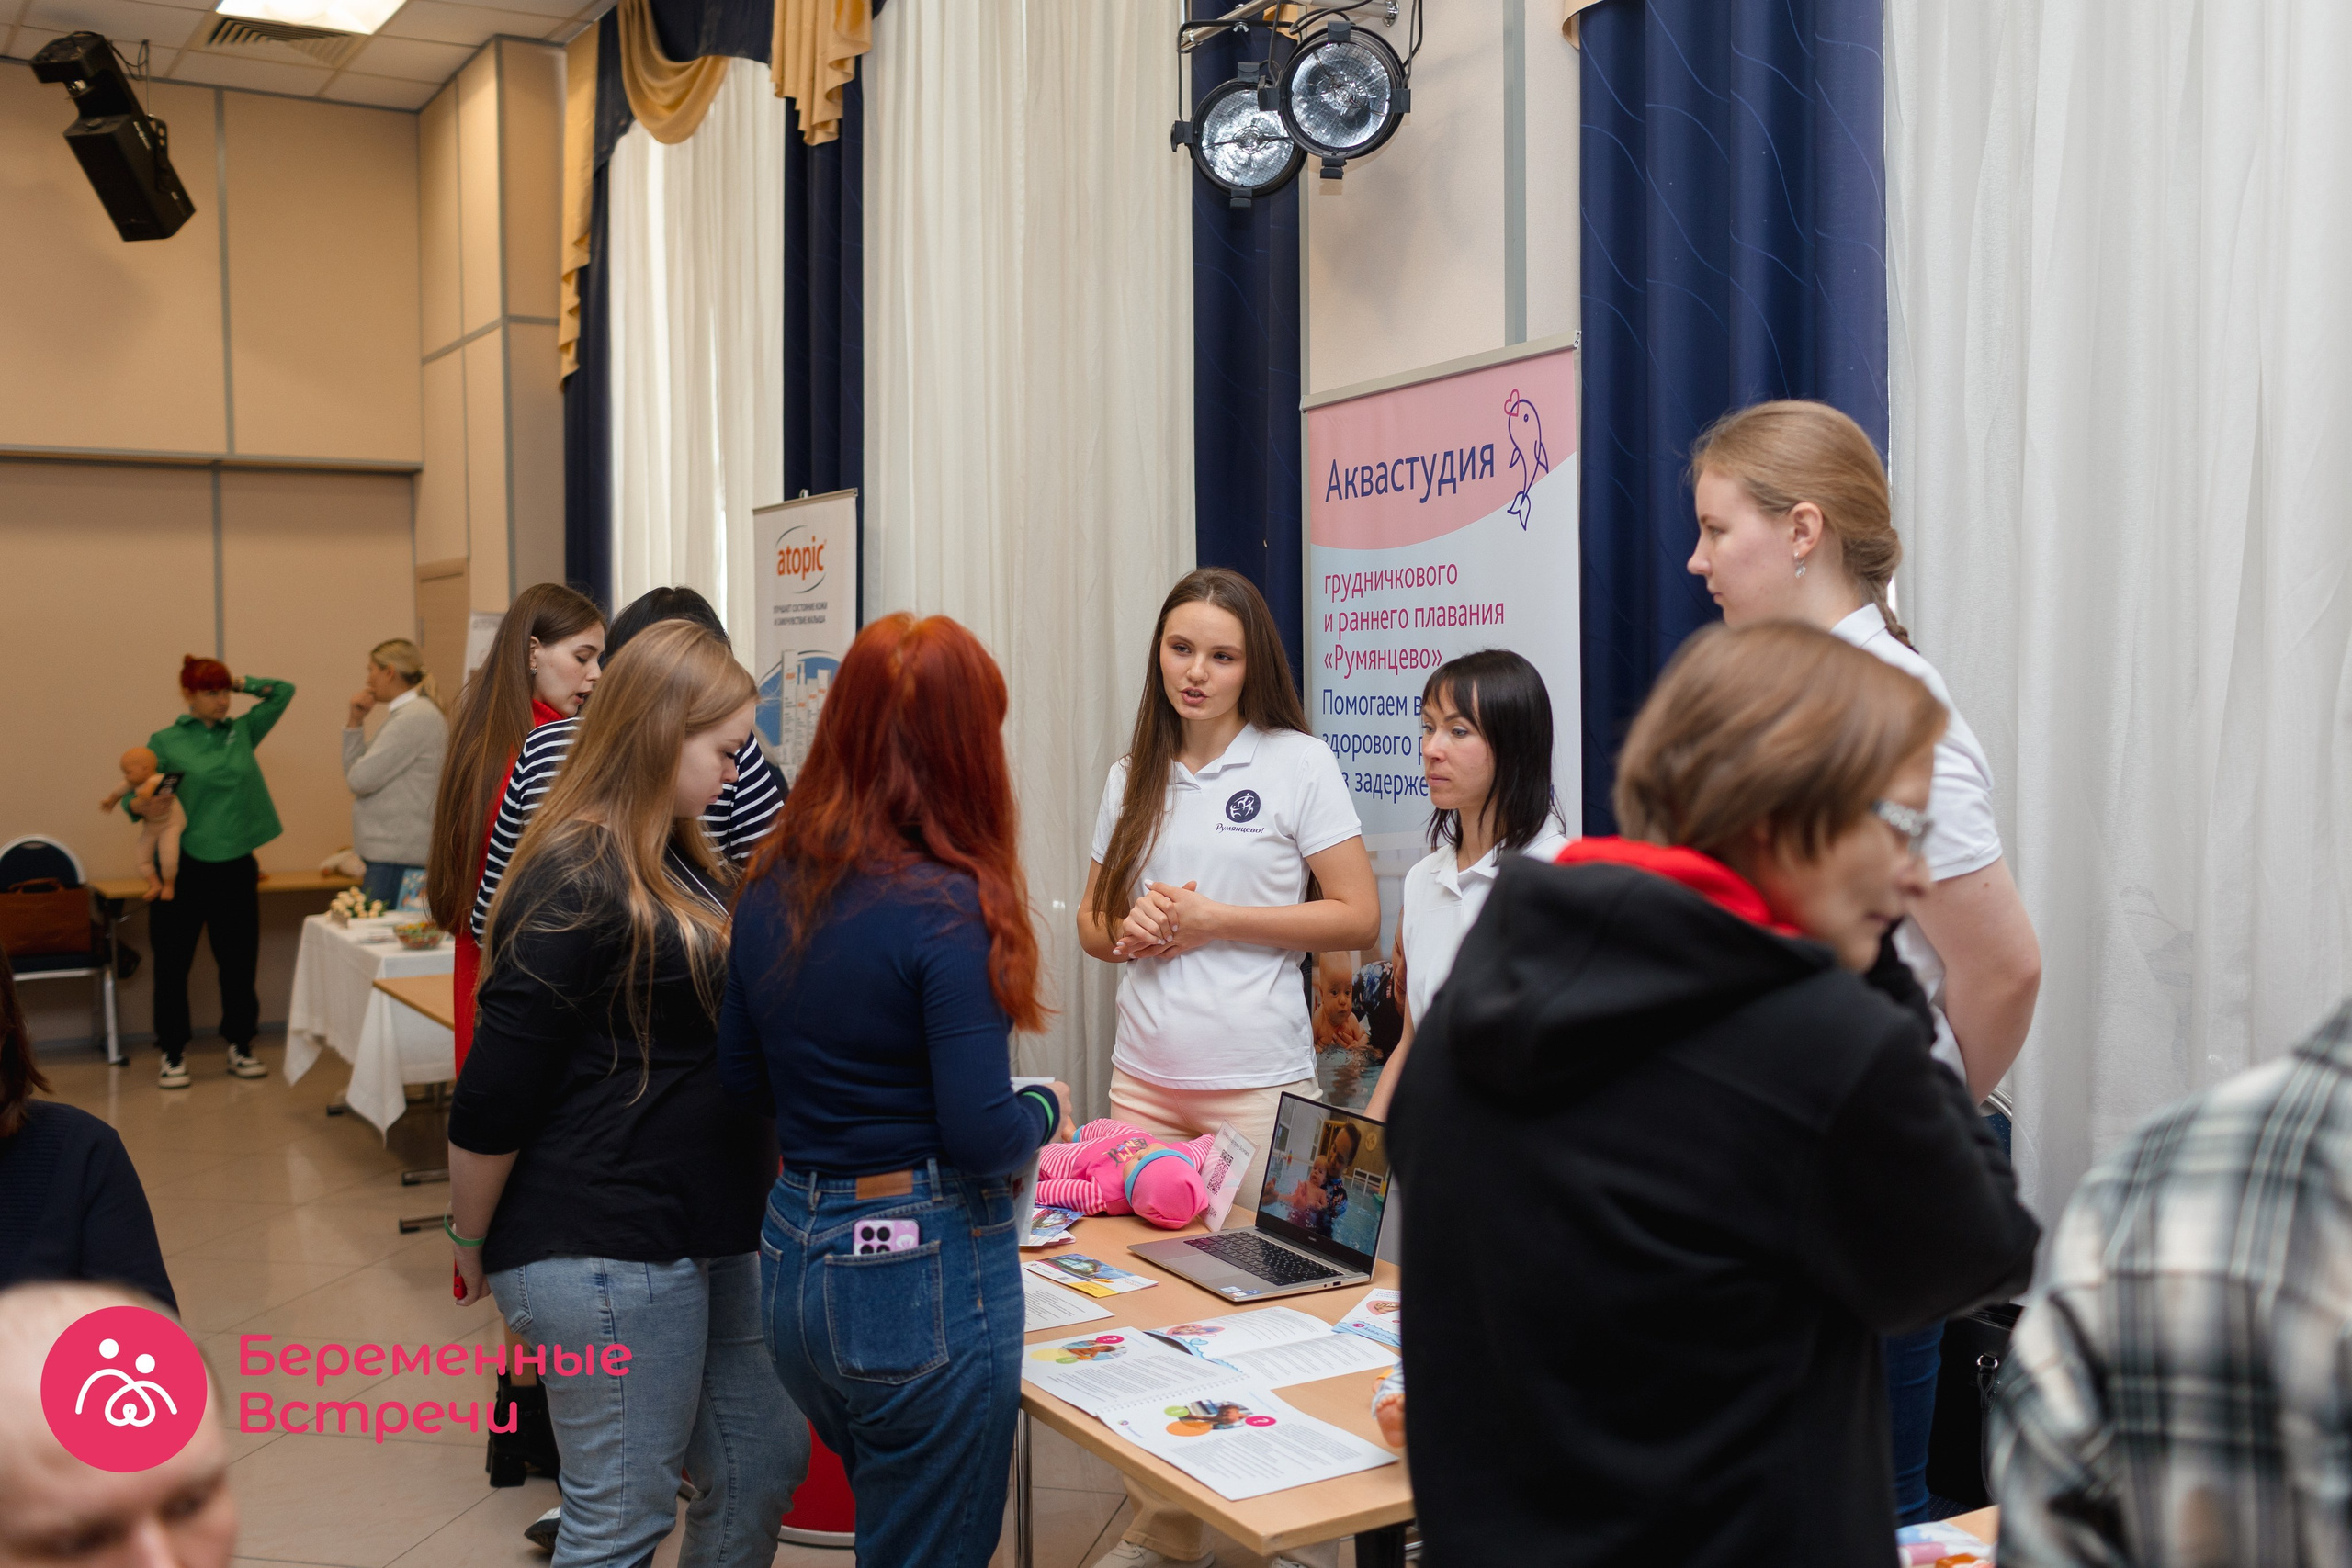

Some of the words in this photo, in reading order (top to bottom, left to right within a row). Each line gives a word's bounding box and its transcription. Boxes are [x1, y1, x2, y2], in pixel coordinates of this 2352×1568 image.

[1325, 443, 1495, 504] Аквастудия
[776, 535, 825, 581] atopic
[1324, 563, 1458, 603] грудничкового
[1324, 613, 1333, 633] и
[1339, 607, 1408, 640] раннего
[1414, 603, 1505, 628] плавания
[1324, 644, 1442, 680] «Румянцево»
[1322, 689, 1408, 716] Помогаем
[1354, 772, 1429, 804] задерже
[1216, 822, 1265, 834] Румянцево!
